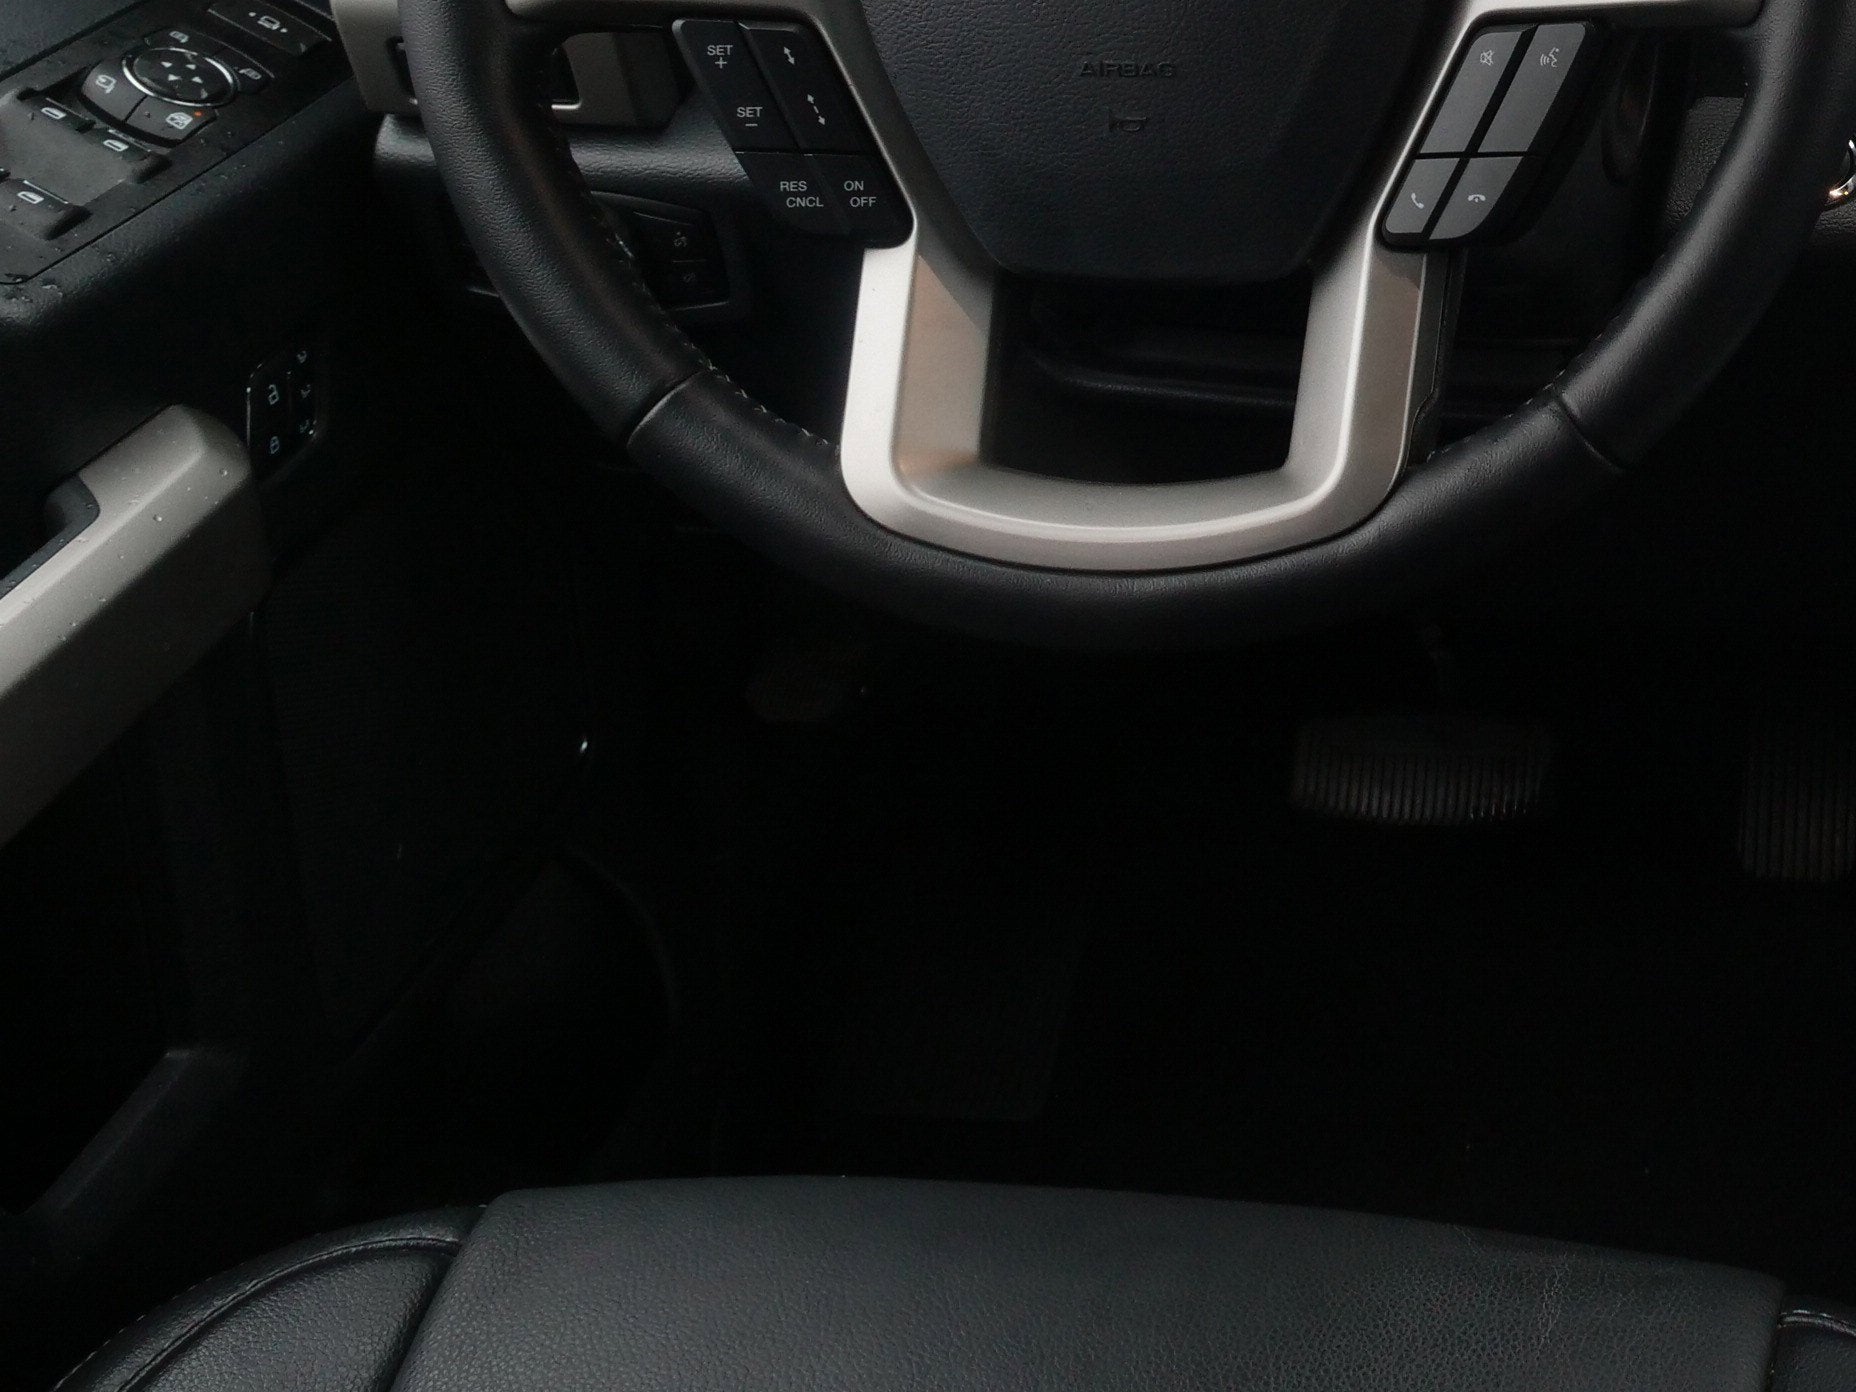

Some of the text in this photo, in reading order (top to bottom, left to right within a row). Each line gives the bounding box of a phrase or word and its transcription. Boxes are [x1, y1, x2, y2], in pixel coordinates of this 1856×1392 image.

[707, 44, 733, 56] SET
[1079, 60, 1176, 77] AIRBAG
[736, 107, 763, 118] SET
[780, 181, 807, 192] RES
[844, 180, 864, 191] ON
[786, 196, 824, 208] CNCL
[850, 196, 877, 208] OFF
